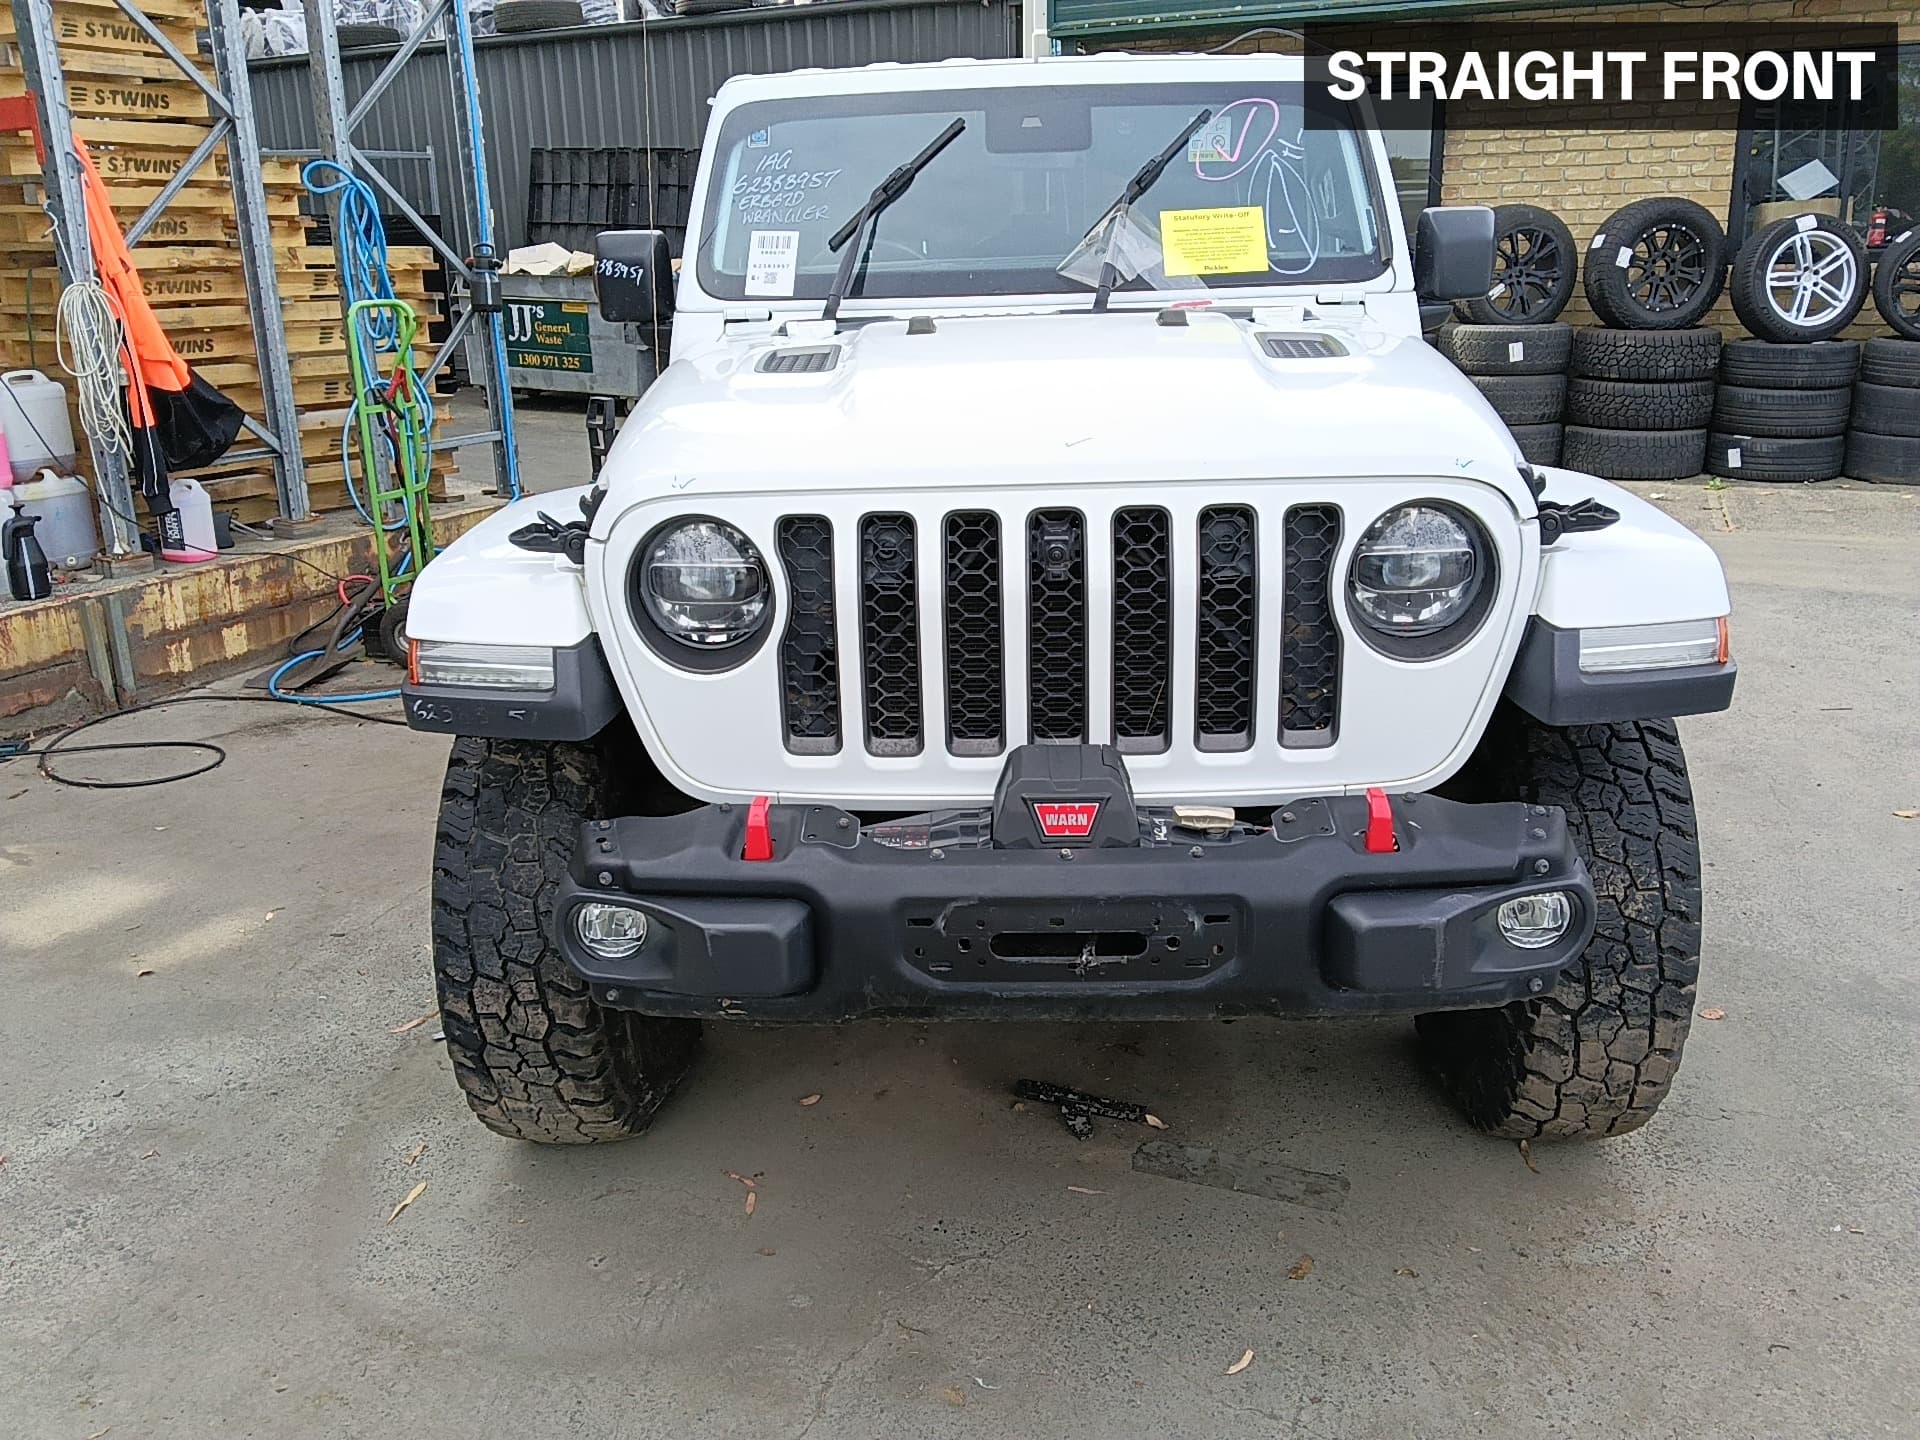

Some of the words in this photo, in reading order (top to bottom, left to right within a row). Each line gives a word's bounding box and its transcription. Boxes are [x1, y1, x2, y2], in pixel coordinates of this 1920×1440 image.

[743, 205, 832, 225] WRANGLER
[534, 321, 571, 334] General
[535, 333, 563, 345] Waste
[518, 353, 541, 366] 1300
[542, 355, 559, 368] 971
[562, 357, 581, 369] 325
[1045, 813, 1088, 826] WARN
